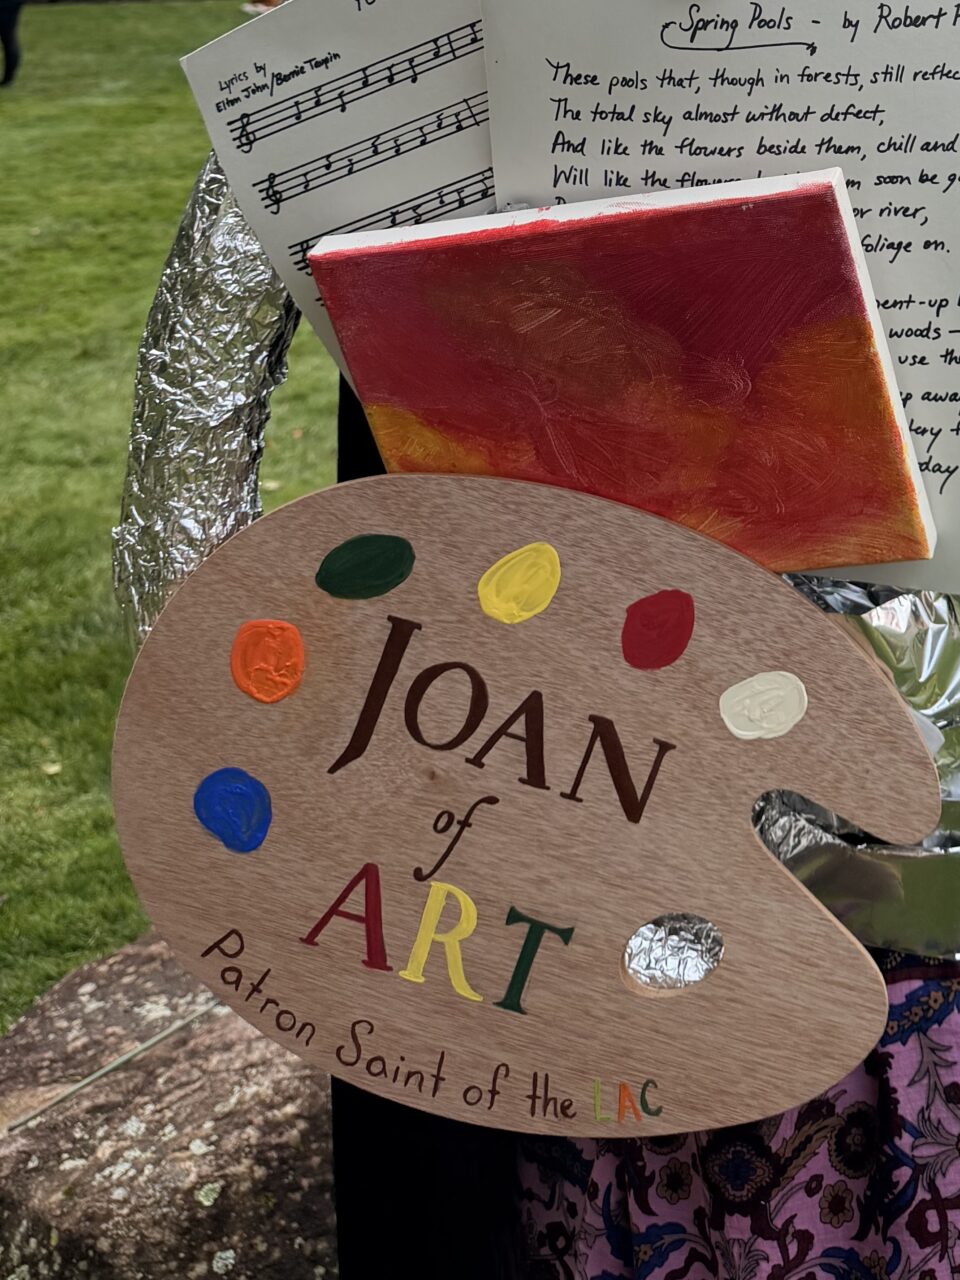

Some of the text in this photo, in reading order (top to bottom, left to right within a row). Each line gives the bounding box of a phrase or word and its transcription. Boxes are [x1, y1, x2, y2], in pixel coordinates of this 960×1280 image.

[677, 3, 739, 50] Spring
[748, 1, 795, 32] Pools
[842, 13, 861, 43] by
[873, 2, 948, 33] Robert
[218, 62, 266, 94] Lyrics by
[545, 57, 600, 87] These
[608, 71, 648, 95] pools
[656, 68, 701, 94] that,
[709, 68, 765, 97] though
[774, 68, 790, 85] in
[797, 65, 864, 92] forests,
[869, 64, 905, 85] still
[215, 96, 242, 113] Elton
[549, 97, 886, 137] The total sky almost without defect,
[551, 130, 587, 157] And
[601, 137, 630, 156] like
[640, 138, 665, 156] the
[674, 137, 745, 158] flowers
[756, 135, 807, 156] beside
[814, 136, 867, 161] them,
[876, 133, 917, 154] chill
[920, 133, 960, 154] and
[552, 164, 589, 188] Will
[604, 170, 631, 188] like
[640, 169, 671, 189] the
[874, 175, 912, 186] soon
[918, 168, 940, 185] be
[878, 202, 929, 227] river,
[861, 234, 950, 264] foliage on.
[888, 321, 942, 340] woods
[898, 353, 930, 366] use
[327, 614, 677, 824] JOAN
[413, 796, 500, 882] of
[299, 862, 575, 1015] ART
[200, 928, 664, 1124] Patron Saint of the LAC
